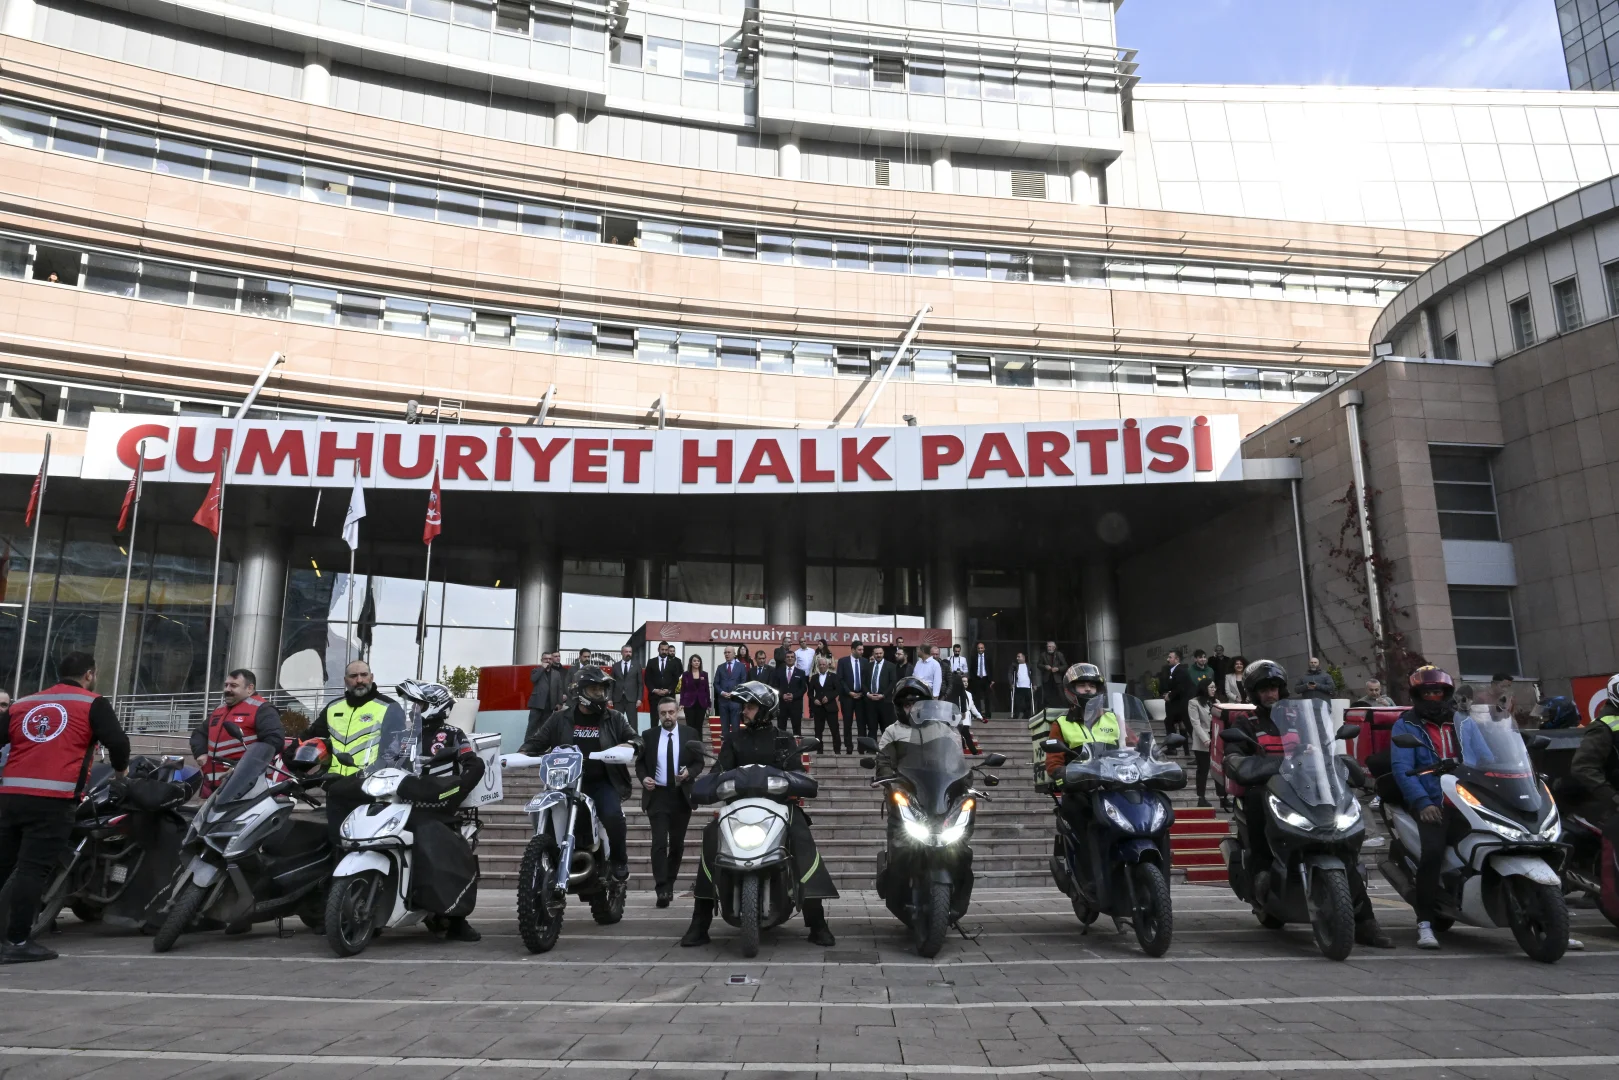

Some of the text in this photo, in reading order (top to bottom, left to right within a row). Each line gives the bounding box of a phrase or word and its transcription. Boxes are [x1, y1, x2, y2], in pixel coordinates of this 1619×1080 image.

[117, 415, 1213, 484] CUMHURİYET HALK PARTİSİ
[710, 627, 893, 643] CUMHURİYET HALK PARTİSİ
[480, 794, 491, 802] OPEN
